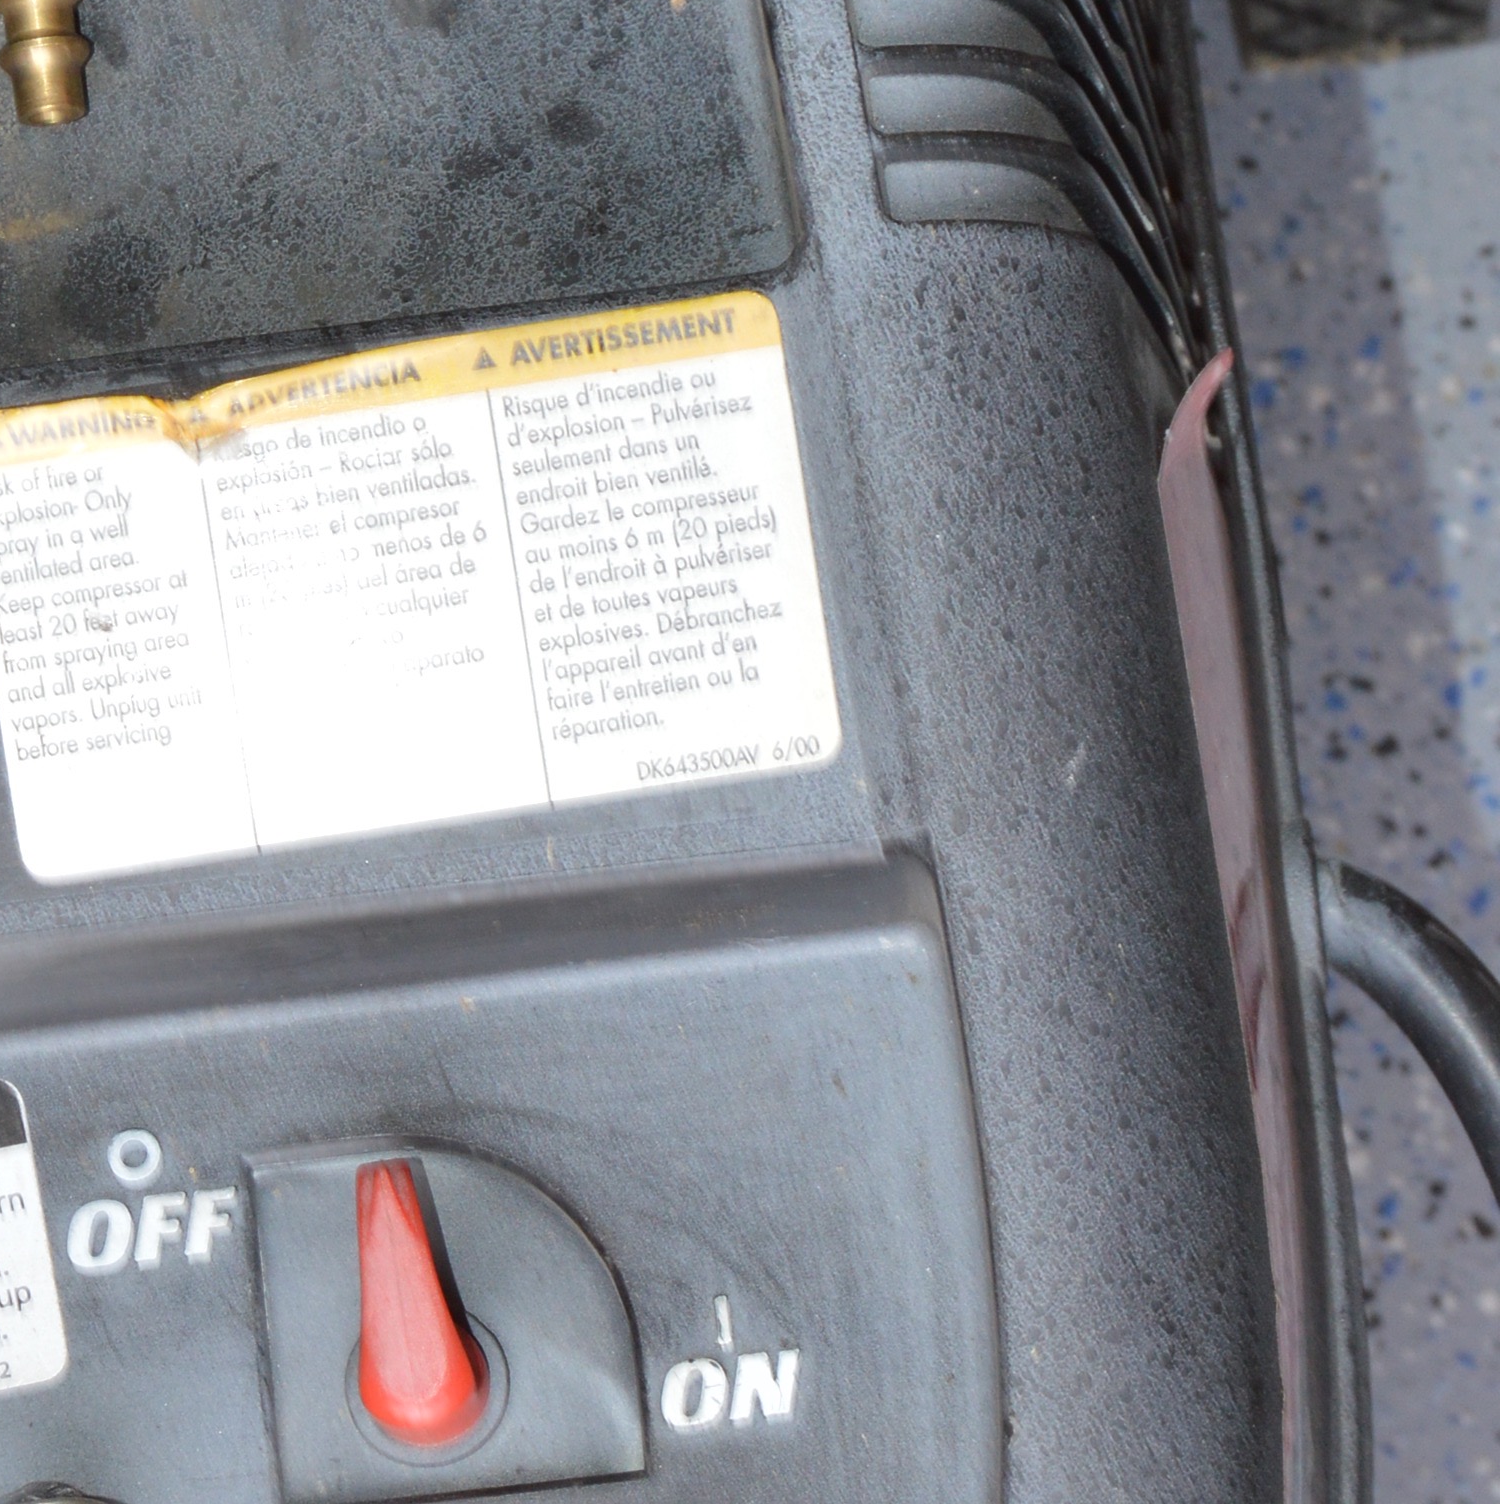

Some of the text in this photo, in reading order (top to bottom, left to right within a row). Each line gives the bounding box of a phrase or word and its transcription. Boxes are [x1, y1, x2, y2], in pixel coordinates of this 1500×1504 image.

[509, 307, 736, 366] AVERTISSEMENT
[229, 358, 422, 418] ADVERTENCIA
[501, 370, 717, 421] Risque d'incendie ou
[6, 408, 158, 447] WARNING
[285, 413, 406, 450] de incendio
[506, 395, 754, 449] d'explosion Pulvérisez
[411, 434, 453, 462] sólo
[511, 432, 701, 477] seulement dans un
[84, 484, 132, 513] Only
[366, 463, 477, 498] ventiladas.
[515, 469, 640, 507] endroit bien
[90, 513, 130, 540] well
[353, 498, 462, 531] compresor
[519, 484, 760, 535] Gardez le compresseur
[439, 522, 466, 547] de
[558, 504, 778, 561] moins pieds)
[449, 550, 477, 577] de
[528, 541, 774, 595] de l'endroit pulvériser
[51, 576, 162, 608] compressor
[558, 577, 739, 620] de toutes vapeurs
[49, 612, 78, 637] 20
[124, 604, 179, 626] away
[538, 596, 784, 656] explosives. Débranchez
[2, 631, 190, 675] from spraying area
[542, 639, 706, 686] l'appareil avant
[7, 674, 46, 704] and
[546, 669, 701, 712] faire l'entretien
[11, 708, 83, 735] vapors.
[551, 706, 666, 745] réparation.
[14, 734, 80, 761] before
[635, 734, 822, 782] DK643500AV 6/00
[67, 1186, 238, 1275] OFF
[660, 1348, 801, 1433] ON
